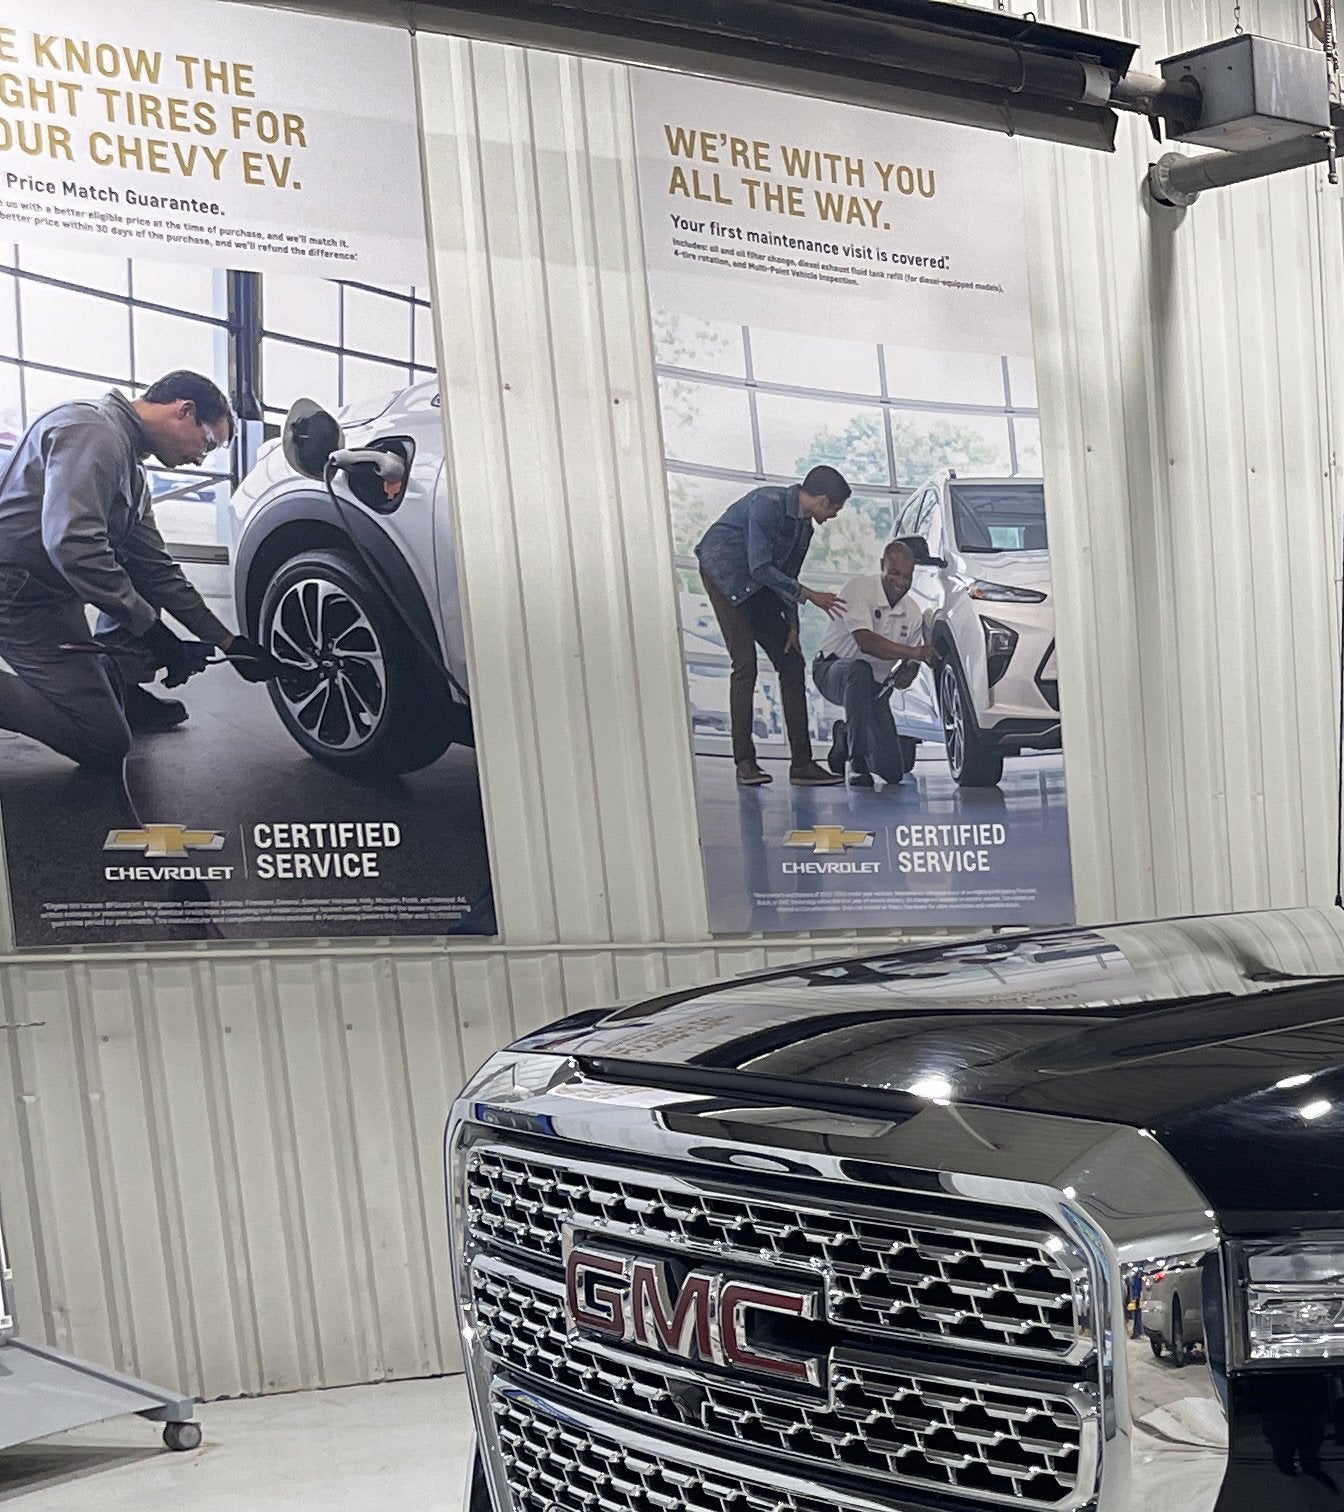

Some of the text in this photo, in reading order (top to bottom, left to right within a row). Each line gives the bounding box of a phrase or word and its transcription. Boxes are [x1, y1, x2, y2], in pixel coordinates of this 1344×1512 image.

[33, 32, 161, 84] KNOW
[175, 54, 256, 97] THE
[96, 87, 217, 136] TIRES
[231, 105, 307, 148] FOR
[89, 131, 228, 180] CHEVY
[243, 151, 301, 190] EV.
[663, 124, 936, 198] WE'RE WITH YOU
[6, 172, 225, 216] Price Match Guarantee.
[668, 166, 891, 230] ALL THE WAY.
[670, 214, 705, 234] Your
[709, 221, 743, 241] first
[747, 230, 839, 256] maintenance
[842, 243, 874, 260] visit
[876, 247, 888, 262] is
[253, 822, 401, 849] CERTIFIED
[896, 824, 1006, 847] CERTIFIED
[104, 866, 234, 882] CHEVROLET
[256, 852, 380, 879] SERVICE
[782, 861, 881, 875] CHEVROLET
[899, 851, 990, 874] SERVICE
[565, 1245, 820, 1388] GMC
